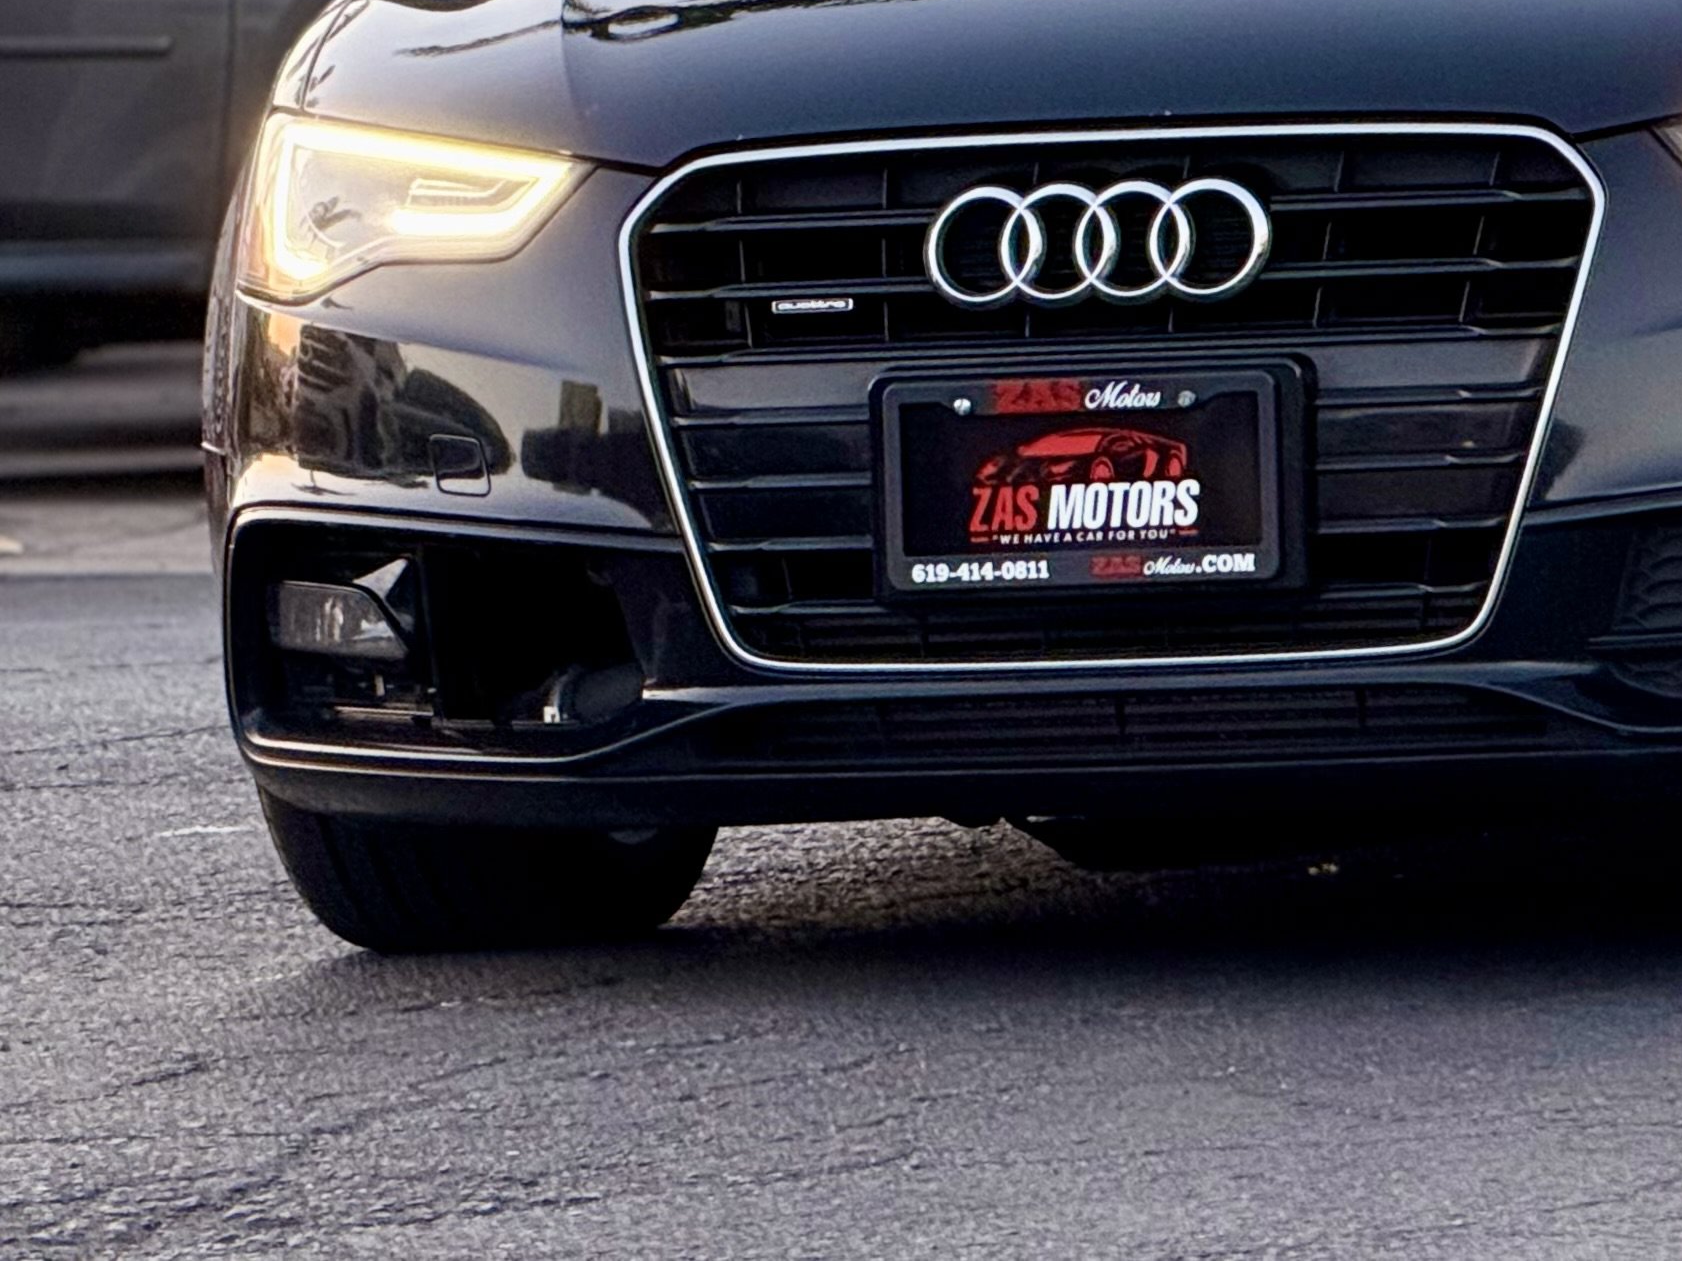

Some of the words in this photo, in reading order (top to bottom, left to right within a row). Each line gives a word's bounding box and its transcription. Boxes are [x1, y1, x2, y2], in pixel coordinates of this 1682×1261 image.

[1085, 381, 1161, 409] Motors
[970, 484, 1039, 531] ZAS
[1047, 479, 1200, 530] MOTORS
[1024, 532, 1060, 544] HAVE
[1062, 532, 1073, 543] A
[1076, 531, 1103, 542] CAR
[1108, 530, 1135, 541] FOR
[911, 560, 1050, 583] 619-414-0811
